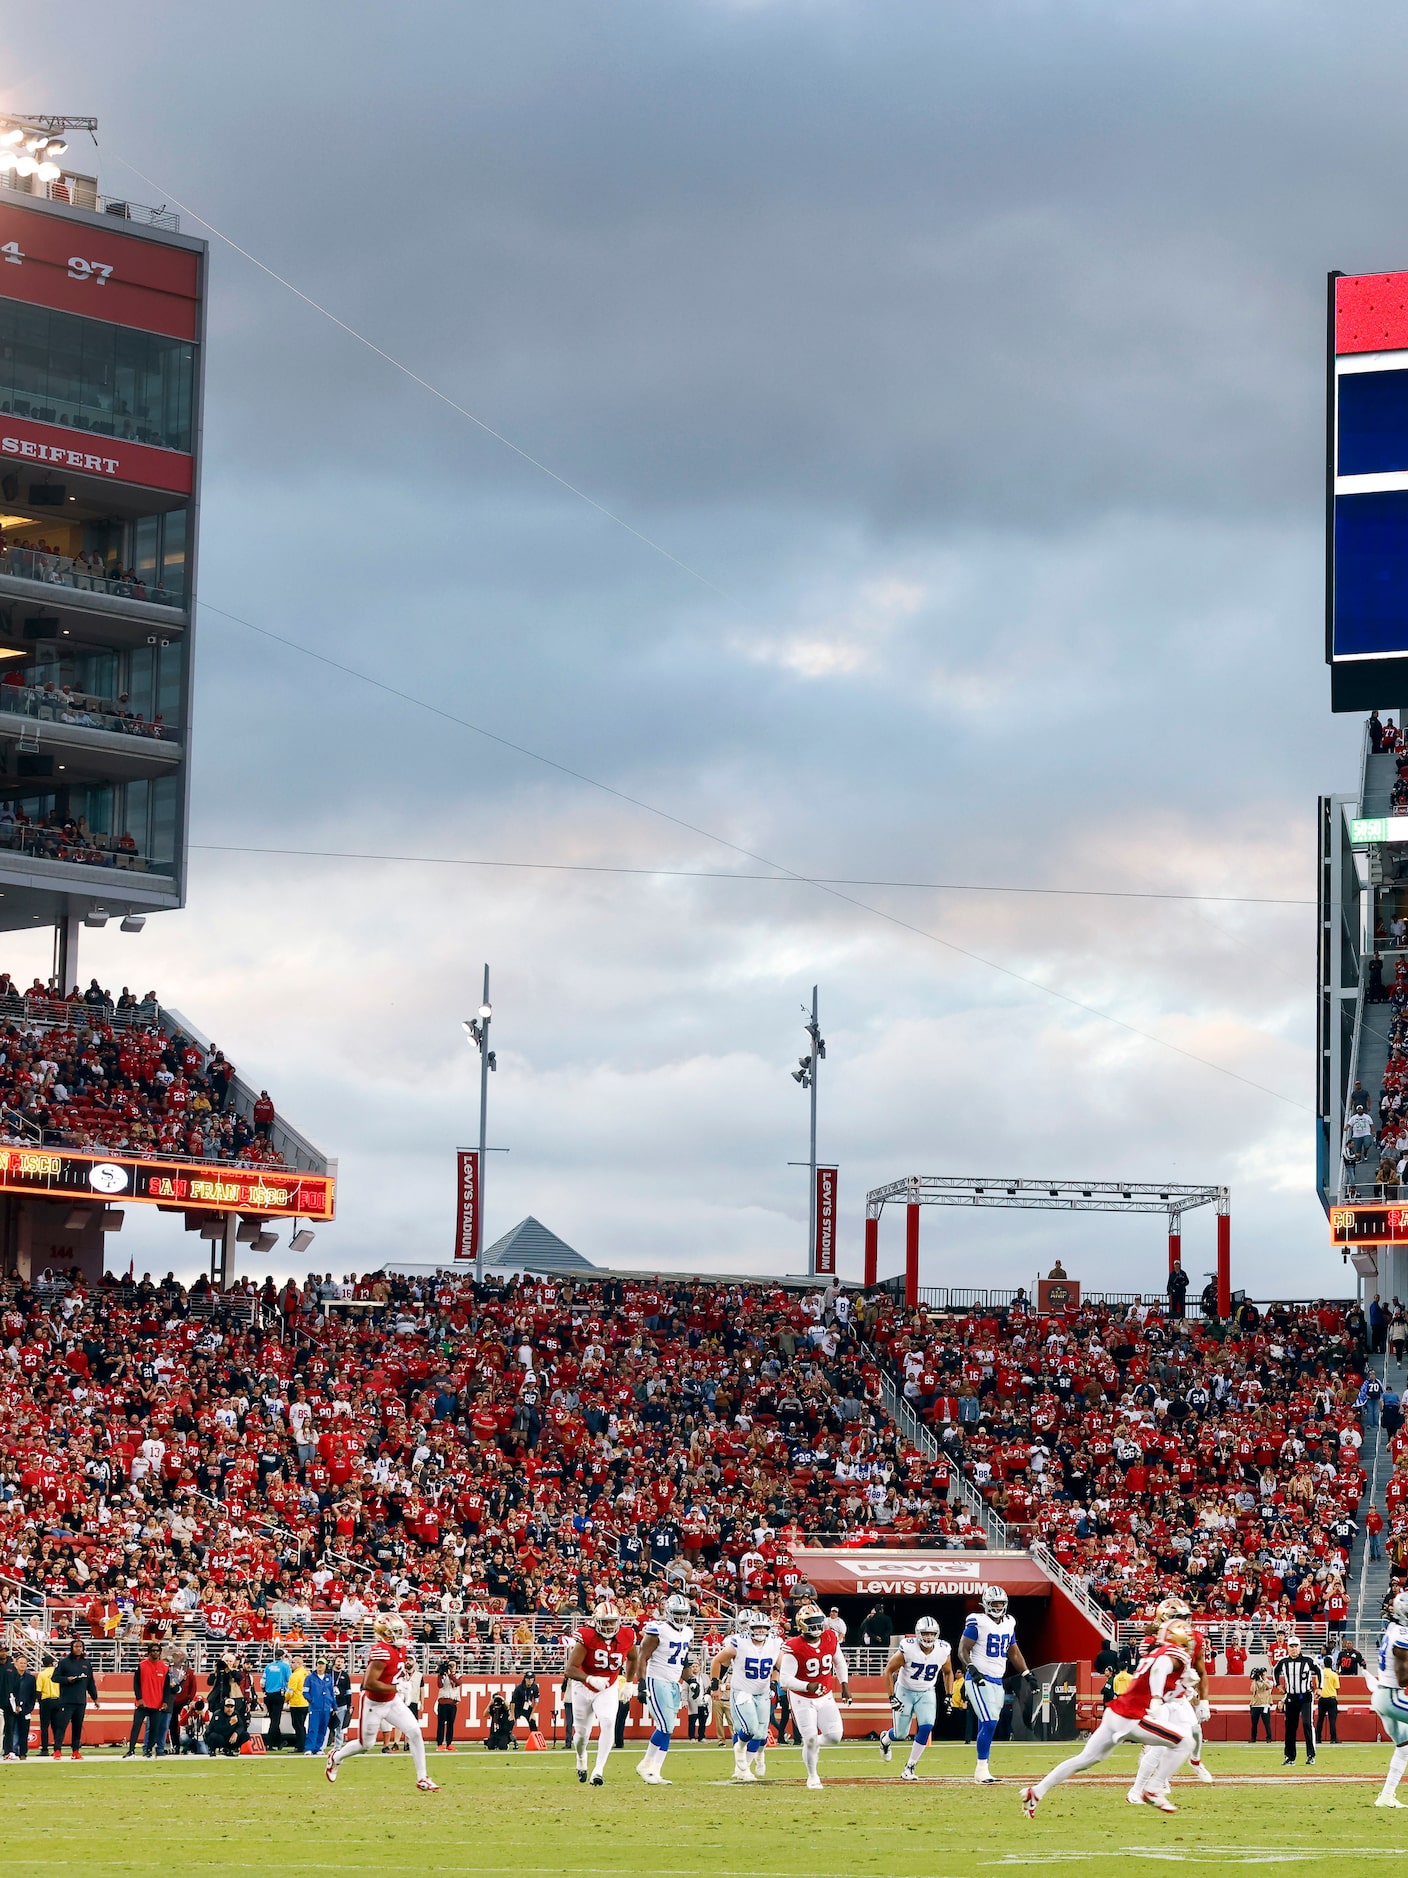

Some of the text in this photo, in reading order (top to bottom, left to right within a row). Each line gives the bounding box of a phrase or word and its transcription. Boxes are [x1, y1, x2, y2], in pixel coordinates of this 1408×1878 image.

[67, 256, 114, 286] 97
[1, 437, 119, 474] SEIFERT
[1384, 729, 1395, 737] 77
[174, 1092, 184, 1101] 23
[149, 1177, 288, 1206] SAN FRANCISCO
[461, 1202, 473, 1256] STADIUM
[821, 1218, 831, 1270] STADIUM
[840, 1302, 846, 1312] 8
[24, 1355, 37, 1366] 23
[1049, 1358, 1059, 1367] 97
[1068, 1360, 1075, 1369] 8
[142, 1368, 152, 1378] 21
[969, 1371, 979, 1381] 16
[279, 1380, 290, 1389] 97
[924, 1376, 934, 1385] 85
[1368, 1384, 1379, 1392] 70
[1193, 1394, 1205, 1404] 24
[387, 1407, 398, 1416] 85
[1037, 1416, 1048, 1426] 85
[1164, 1441, 1175, 1449] 54
[1241, 1444, 1249, 1453] 16
[1396, 1440, 1402, 1448] 8
[171, 1458, 181, 1468] 52
[314, 1470, 324, 1479] 19
[457, 1474, 466, 1483] 97
[978, 1471, 988, 1479] 88
[1348, 1488, 1358, 1497] 23
[1391, 1485, 1401, 1494] 21
[469, 1498, 480, 1507] 97
[232, 1506, 242, 1515] 97
[1261, 1508, 1272, 1517] 88
[1336, 1524, 1349, 1536] 88
[657, 1536, 669, 1546] 31
[784, 1574, 797, 1584] 80
[919, 1581, 988, 1595] STADIUM
[1226, 1581, 1238, 1591] 85
[1331, 1598, 1342, 1608] 81
[158, 1619, 172, 1630] 80
[211, 1613, 226, 1626] 97
[986, 1634, 1009, 1657] 60
[1273, 1649, 1287, 1660] 23
[594, 1649, 623, 1671] 93
[744, 1657, 773, 1680] 56
[805, 1653, 833, 1678] 99
[910, 1662, 939, 1681] 78
[251, 1736, 265, 1753] 20
[536, 1732, 546, 1749] 10
